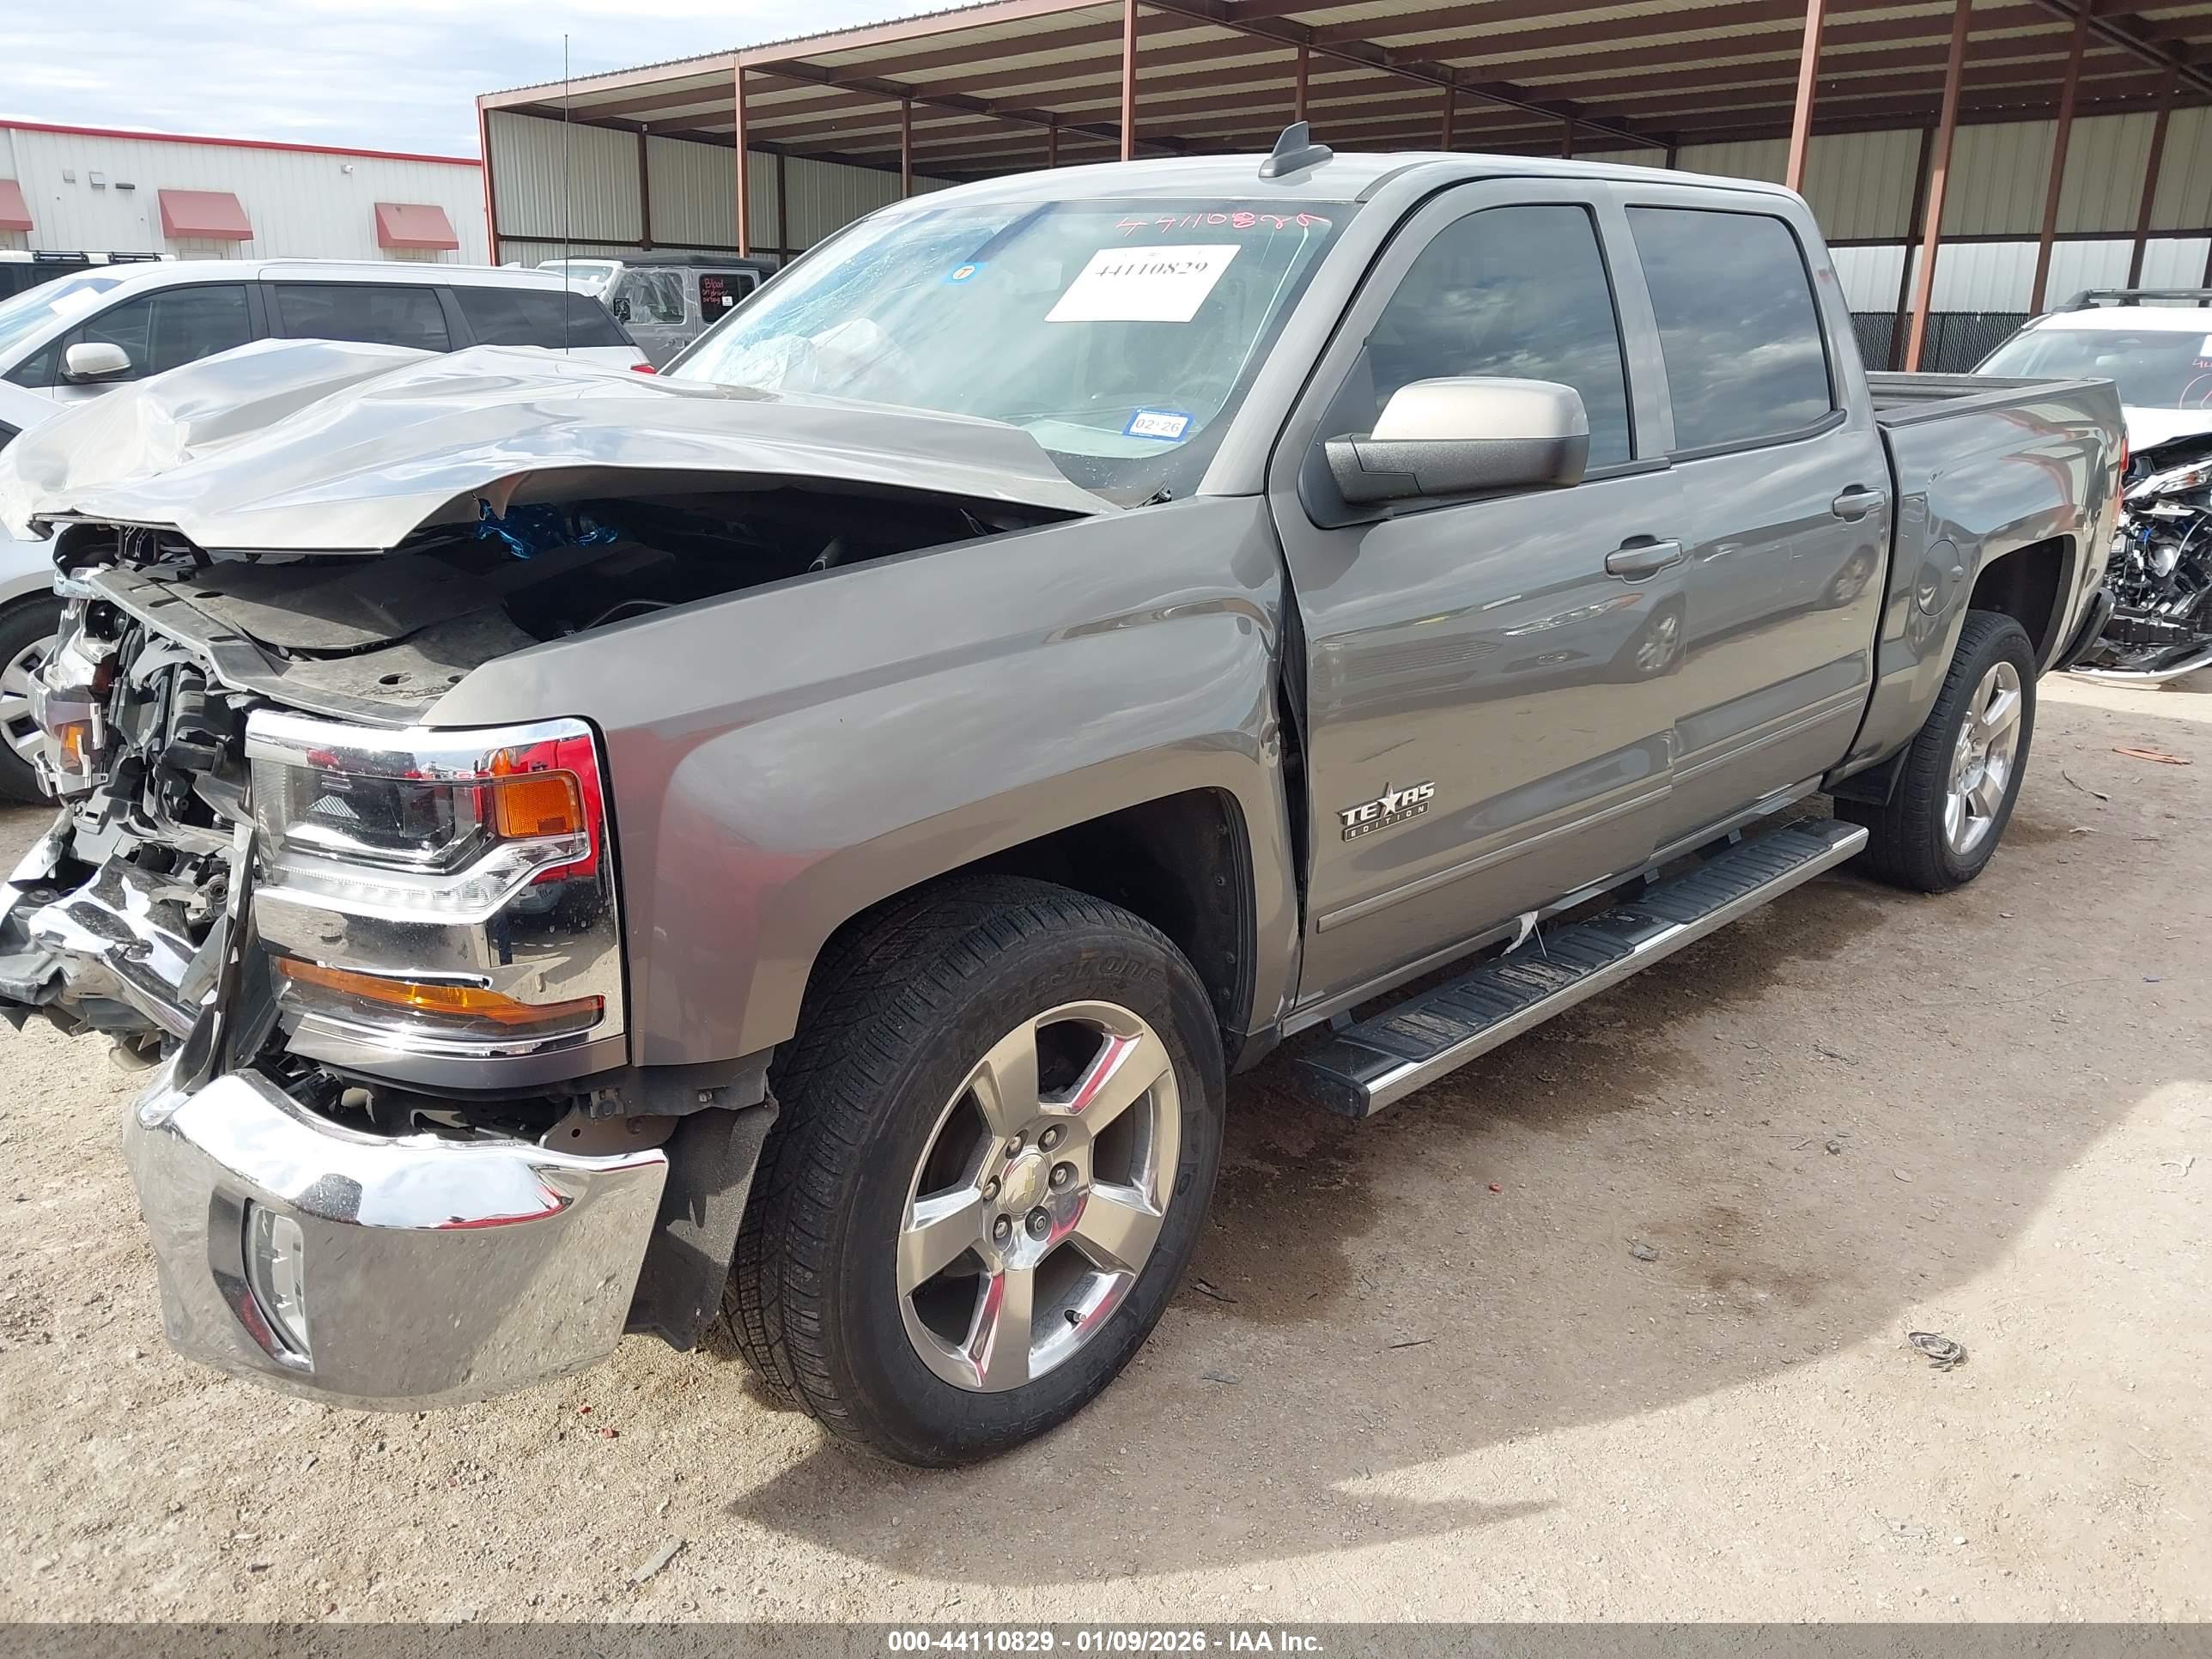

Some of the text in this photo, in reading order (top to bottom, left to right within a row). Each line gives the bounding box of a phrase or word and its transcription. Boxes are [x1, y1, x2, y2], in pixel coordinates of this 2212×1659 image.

[1095, 262, 1209, 276] 44110829
[1135, 418, 1182, 433] 02 26
[1338, 782, 1436, 826] TEXAS
[1350, 805, 1425, 837] EDITION
